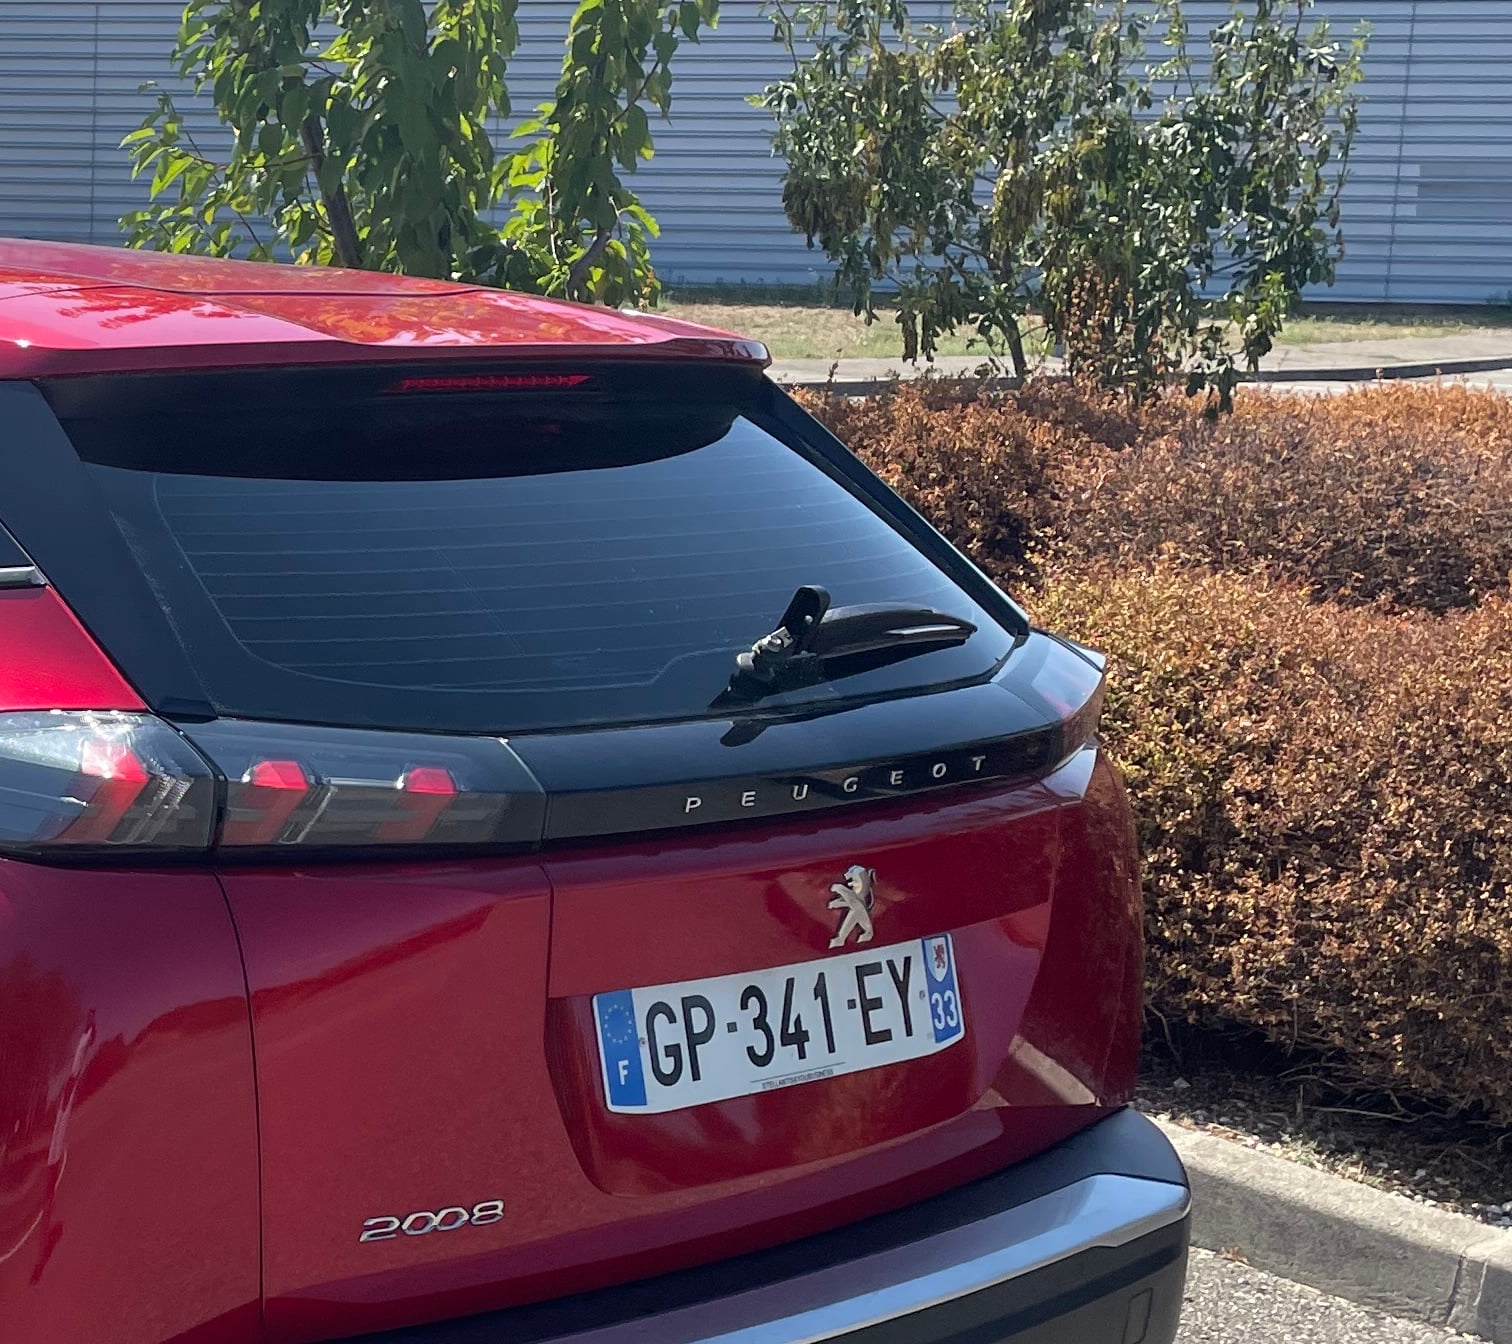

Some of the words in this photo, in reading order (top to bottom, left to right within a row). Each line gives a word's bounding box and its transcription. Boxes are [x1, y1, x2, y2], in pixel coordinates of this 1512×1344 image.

[684, 755, 986, 814] PEUGEOT
[931, 992, 958, 1031] 33
[618, 1059, 630, 1086] F
[359, 1199, 504, 1243] 2008
